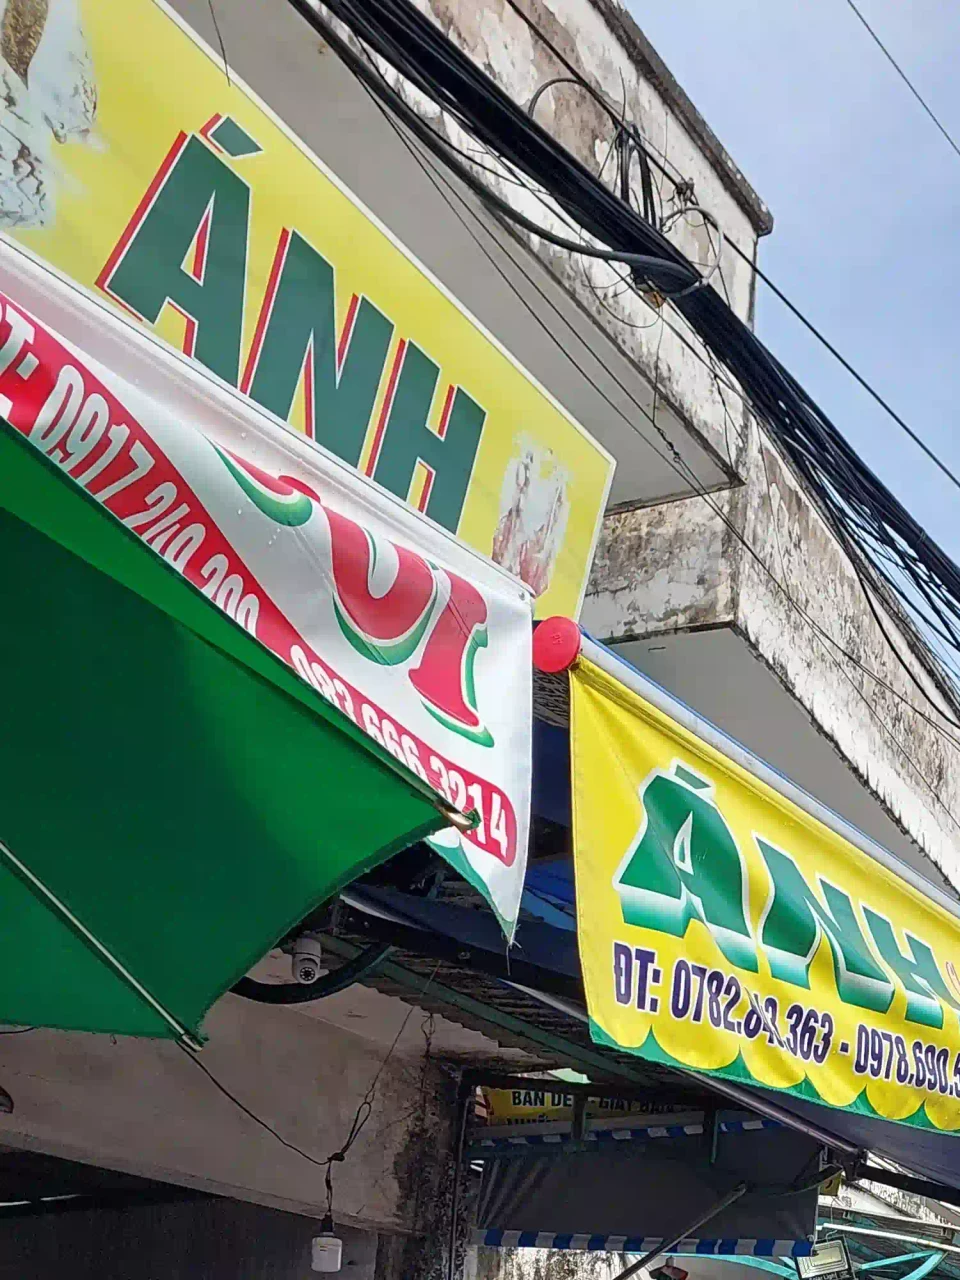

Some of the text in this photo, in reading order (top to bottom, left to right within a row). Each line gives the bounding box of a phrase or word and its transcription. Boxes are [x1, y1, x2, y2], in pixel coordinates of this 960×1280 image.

[96, 112, 487, 536] ÁNH
[28, 364, 156, 503] 0917
[613, 941, 662, 1013] ĐT:
